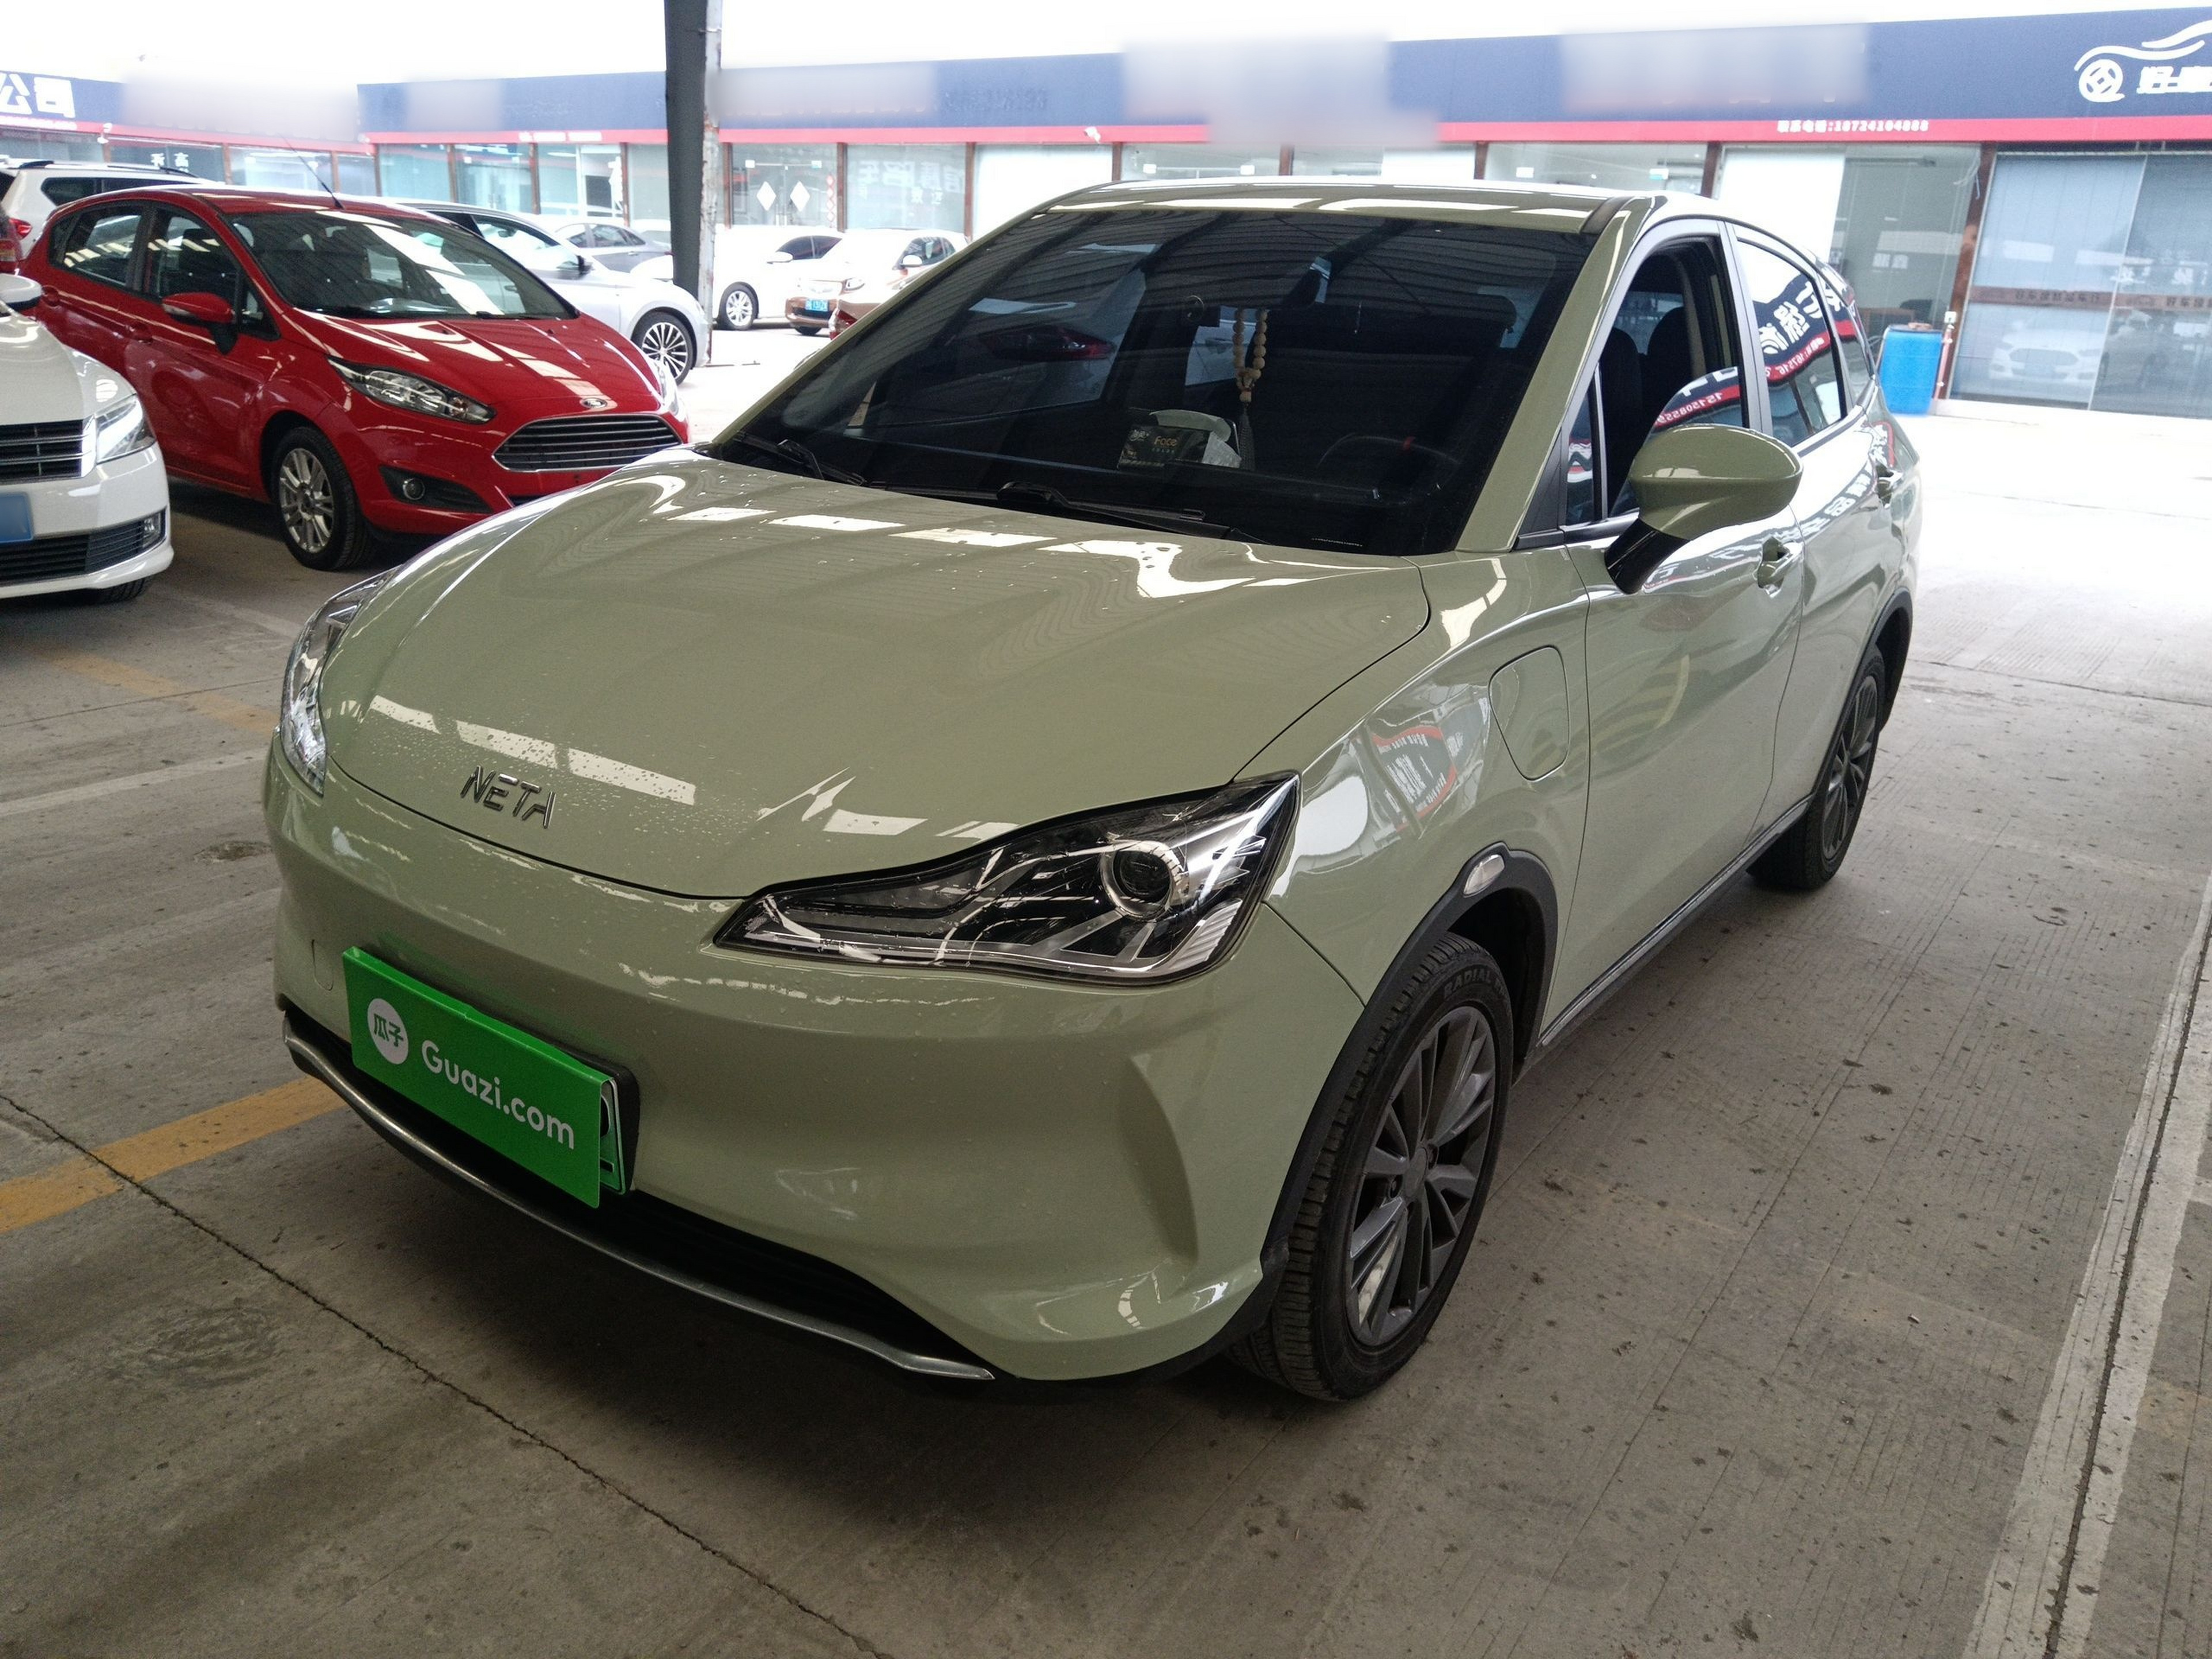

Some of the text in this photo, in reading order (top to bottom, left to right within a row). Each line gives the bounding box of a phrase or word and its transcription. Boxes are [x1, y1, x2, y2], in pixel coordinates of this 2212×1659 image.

[460, 765, 556, 830] NETA
[373, 1013, 404, 1047] 瓜子
[421, 1039, 574, 1150] Guazi.com
